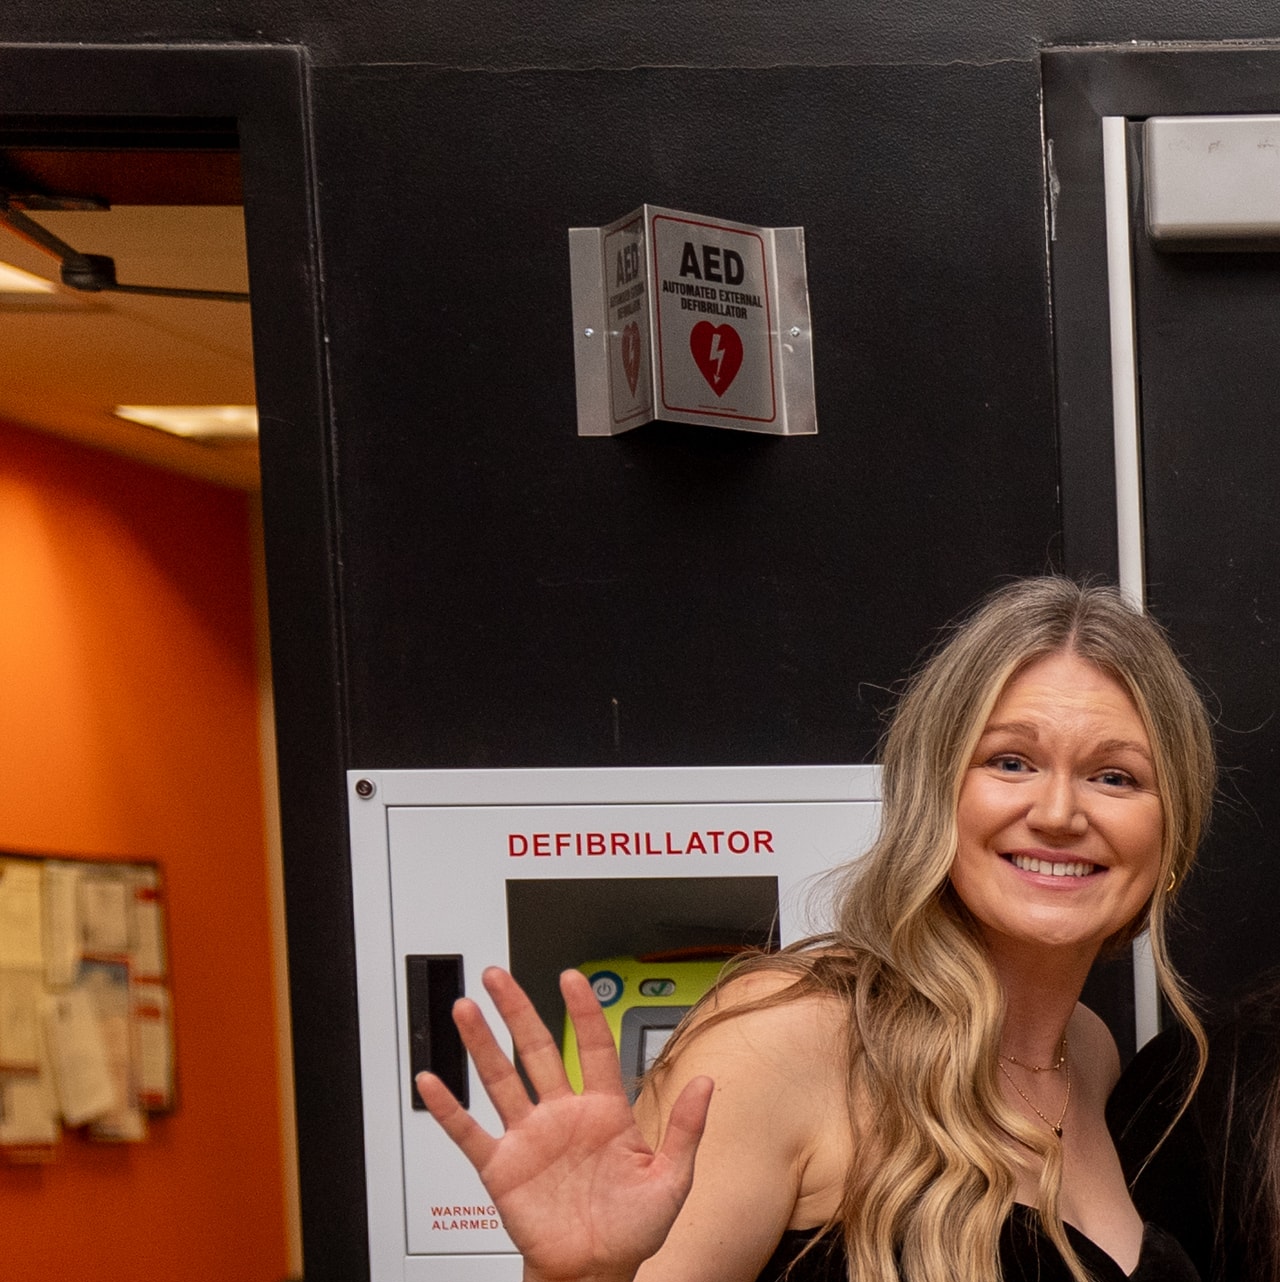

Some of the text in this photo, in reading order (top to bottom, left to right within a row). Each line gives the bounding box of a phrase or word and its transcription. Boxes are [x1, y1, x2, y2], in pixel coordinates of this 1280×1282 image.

[616, 242, 639, 288] AED
[679, 242, 744, 286] AED
[662, 280, 717, 300] AUTOMATED
[719, 289, 763, 308] EXTERNAL
[680, 297, 748, 320] DEFIBRILLATOR
[507, 830, 775, 858] DEFIBRILLATOR
[431, 1206, 496, 1216] WARNING
[432, 1219, 499, 1230] ALARMED
